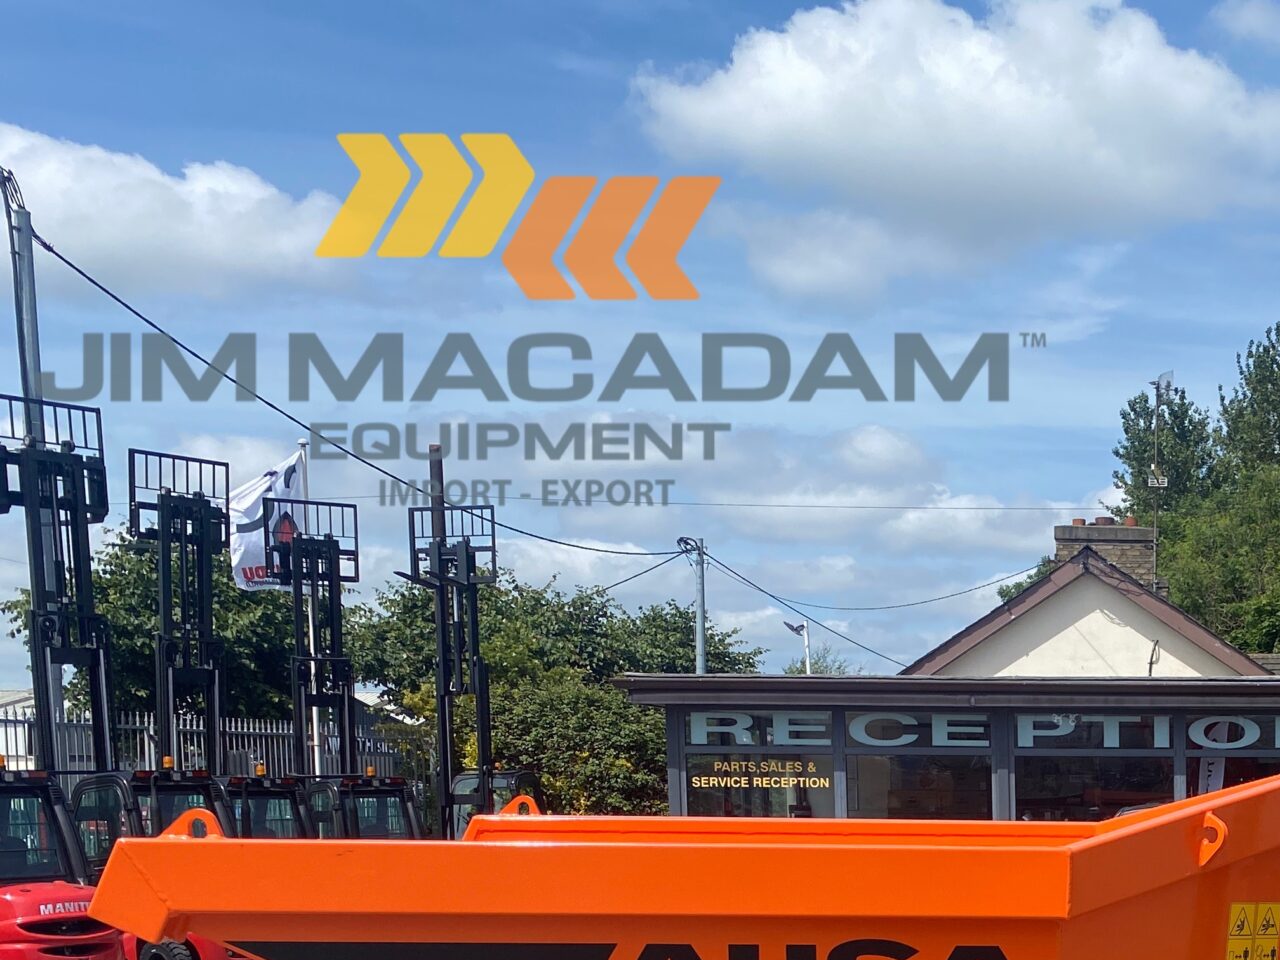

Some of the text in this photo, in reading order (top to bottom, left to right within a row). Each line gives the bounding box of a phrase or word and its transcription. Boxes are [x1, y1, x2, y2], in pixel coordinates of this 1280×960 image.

[807, 761, 817, 773] &
[691, 776, 830, 788] SERVICE RECEPTION
[39, 901, 91, 916] MANIT
